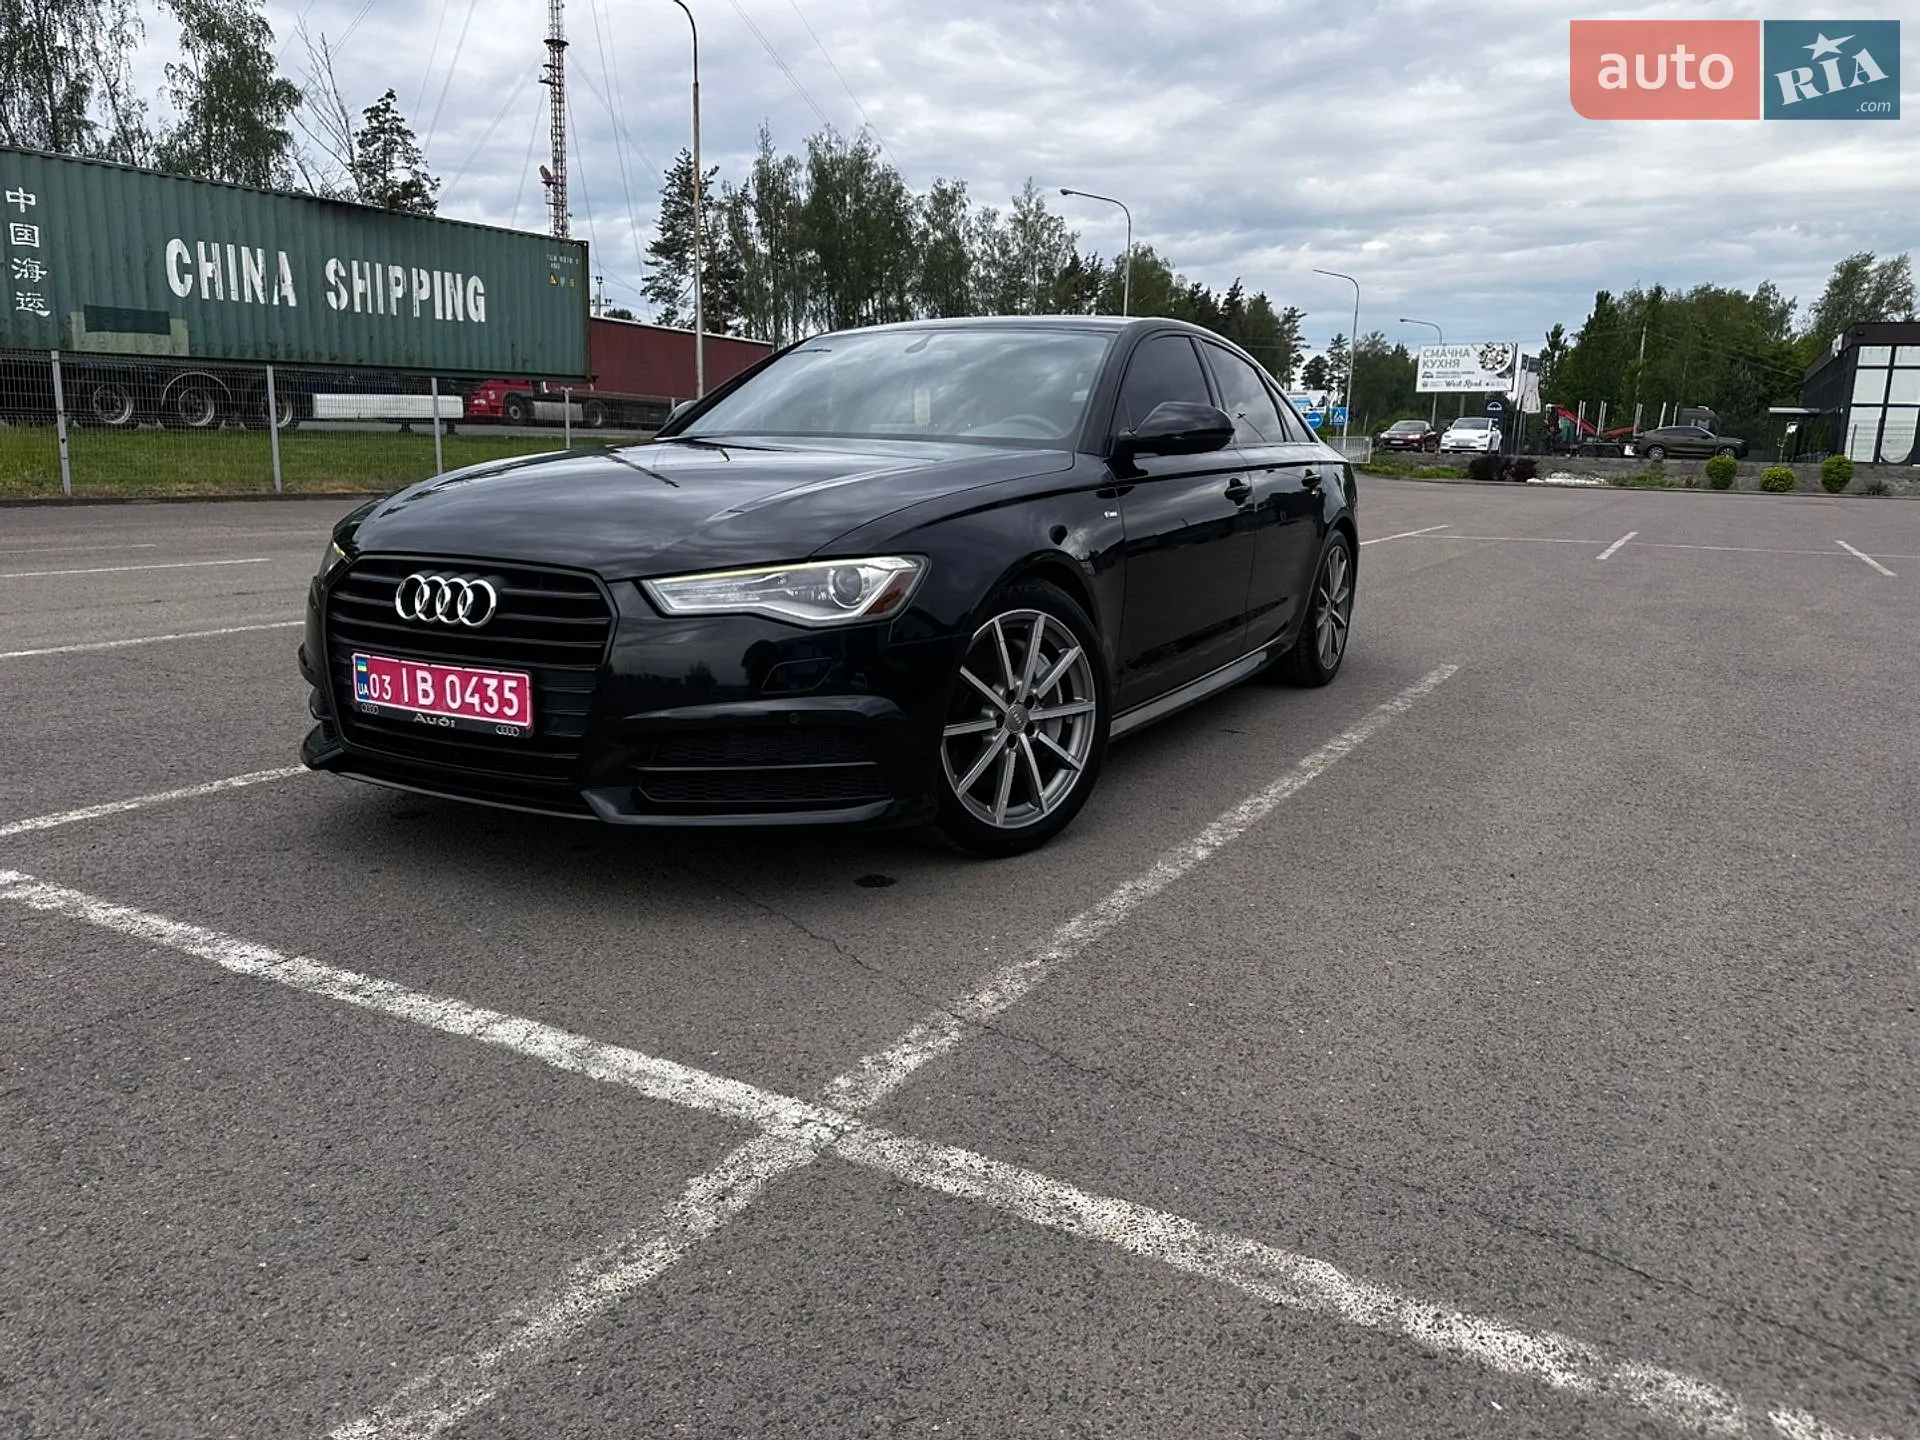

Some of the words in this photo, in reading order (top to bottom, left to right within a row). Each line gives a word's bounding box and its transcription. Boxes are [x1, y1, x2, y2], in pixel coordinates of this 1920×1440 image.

[5, 186, 51, 317] 中国海运
[165, 238, 297, 307] CHINA
[324, 257, 486, 323] SHIPPING
[1422, 359, 1460, 368] КУХНЯ
[1423, 348, 1470, 358] СМАЧНА
[357, 682, 369, 695] UA
[369, 674, 392, 700] 03
[402, 667, 435, 706] IB
[445, 674, 519, 716] 0435
